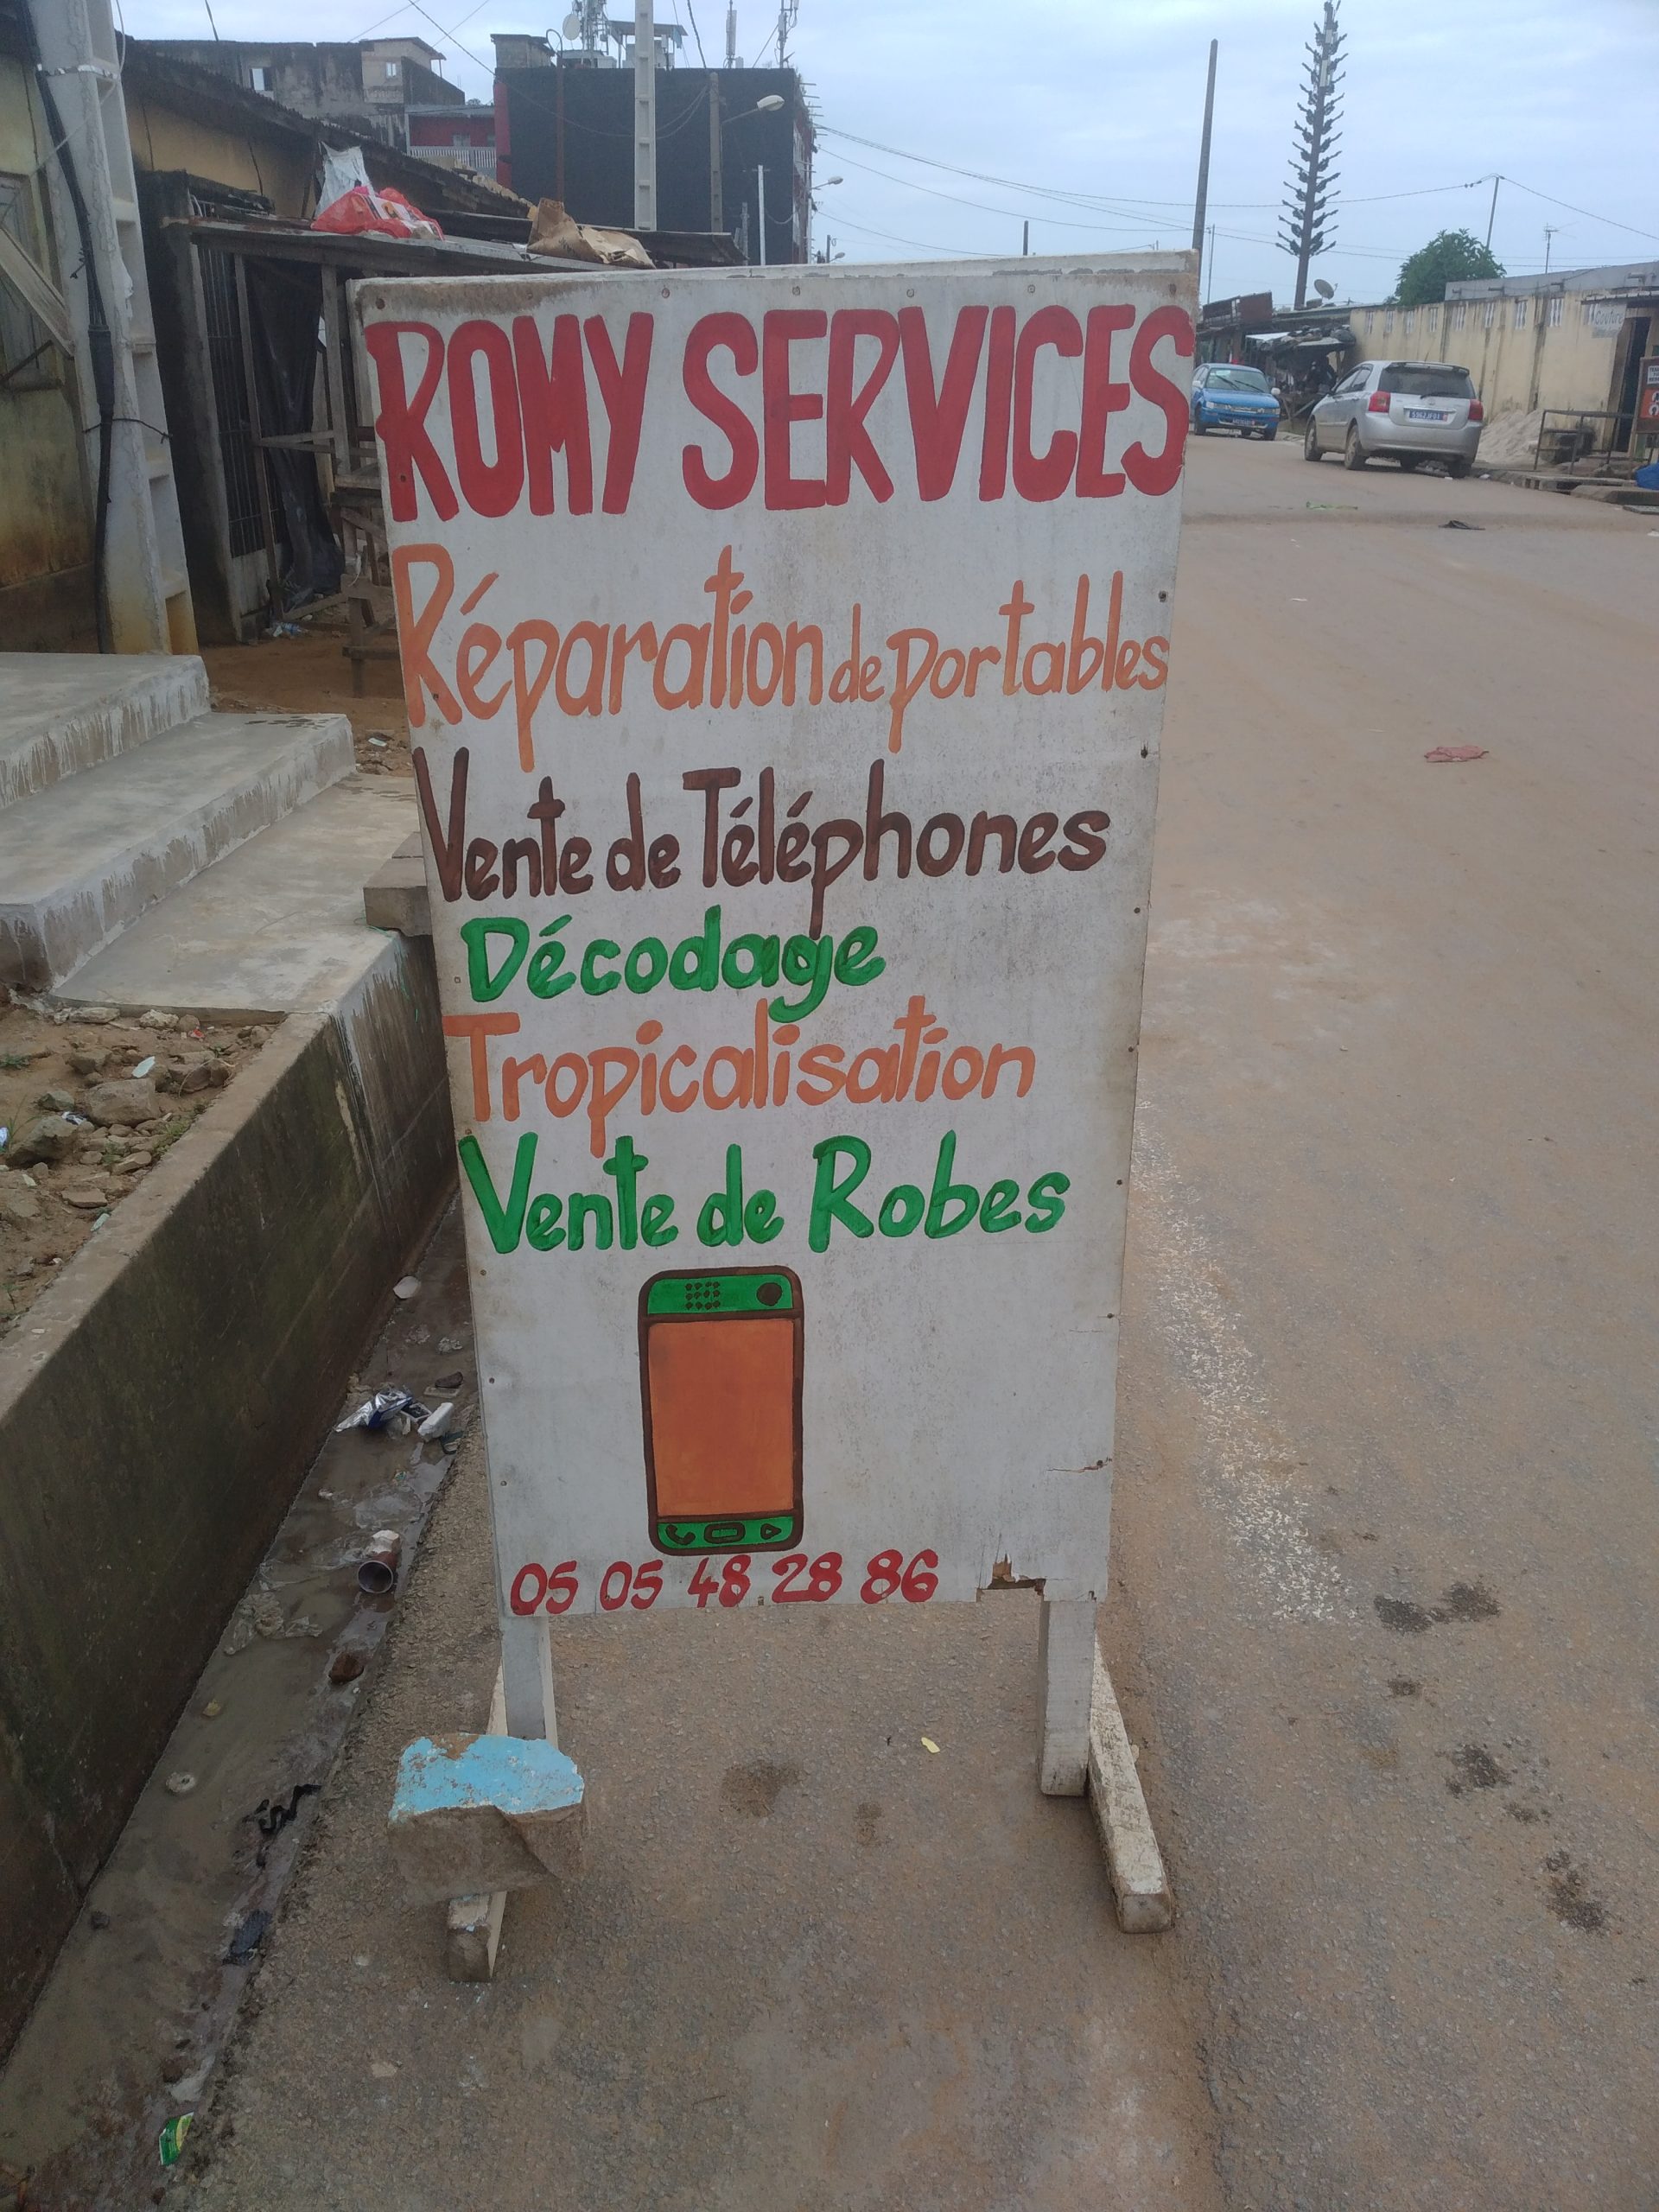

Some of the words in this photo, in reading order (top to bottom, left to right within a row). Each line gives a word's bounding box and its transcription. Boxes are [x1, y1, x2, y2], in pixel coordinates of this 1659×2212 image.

[365, 312, 654, 522] ROMY
[683, 304, 1194, 510] SERVICES
[391, 543, 823, 772] Réparation
[830, 604, 884, 703] de
[412, 747, 593, 902] Vente
[606, 772, 681, 892] de
[683, 760, 1111, 939] Téléphones
[461, 905, 887, 1023] Décodage
[442, 995, 1035, 1159] Tropicalisation
[457, 1133, 678, 1254] Vente
[696, 1143, 784, 1247] de
[808, 1130, 1071, 1253] Robes
[510, 1560, 579, 1616] 05
[600, 1559, 664, 1611] 05
[688, 1554, 752, 1608] 48
[772, 1551, 842, 1604] 28
[860, 1548, 939, 1605] 86
